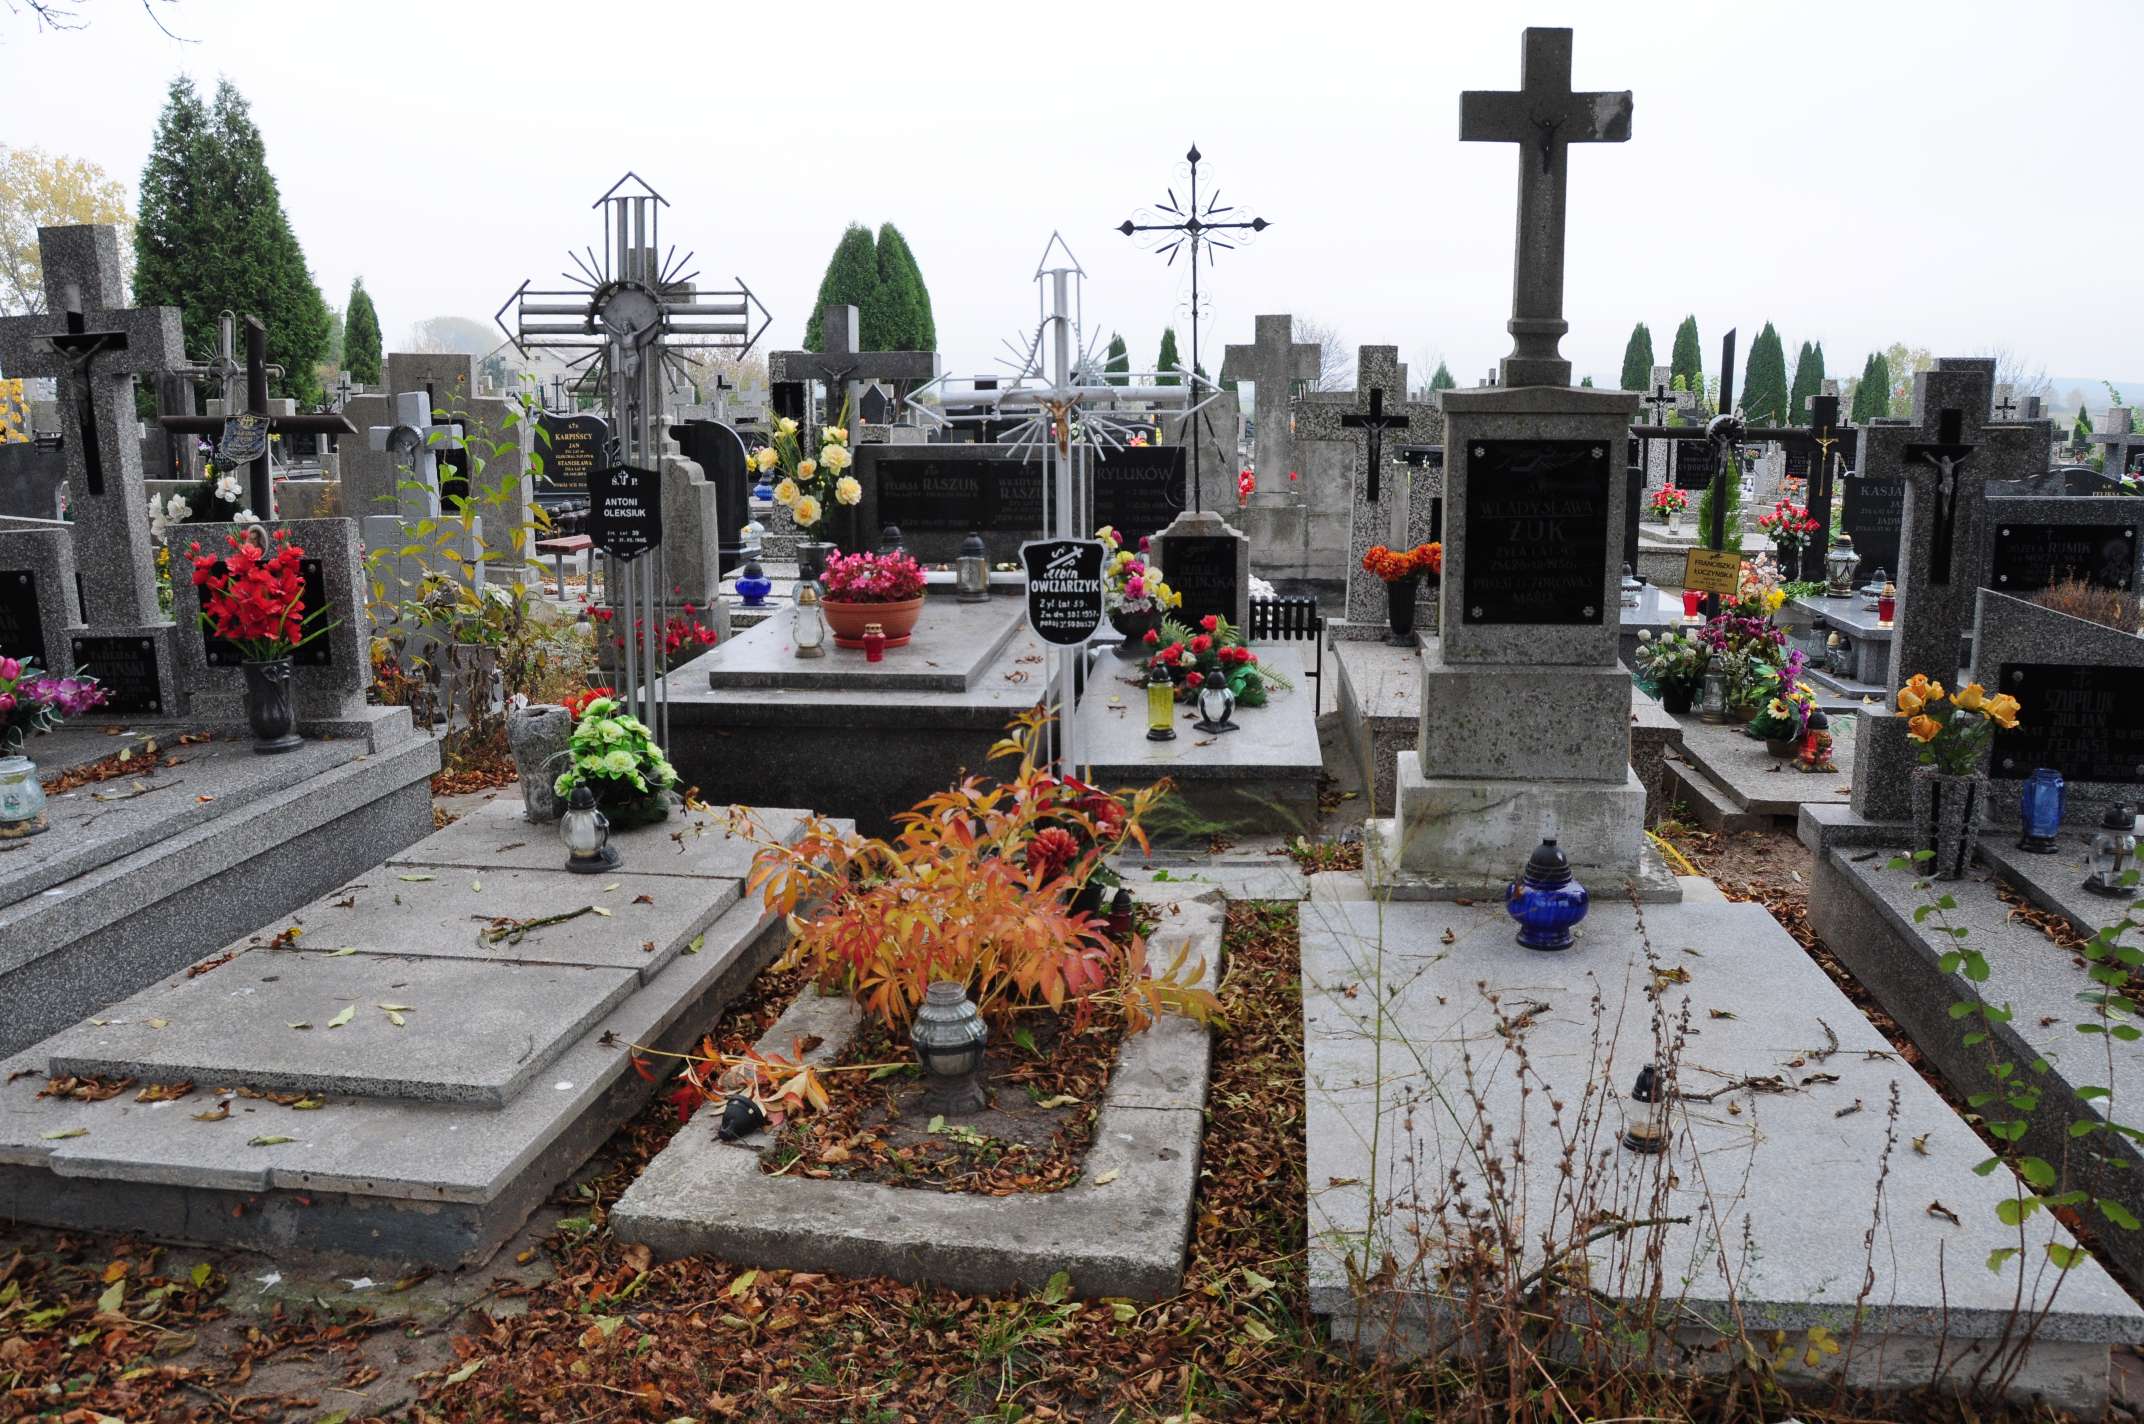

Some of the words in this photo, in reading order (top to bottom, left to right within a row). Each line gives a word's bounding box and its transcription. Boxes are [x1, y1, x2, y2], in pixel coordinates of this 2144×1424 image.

[555, 432, 593, 441] KARPIŃSCY
[922, 477, 980, 491] RASZUK
[605, 497, 638, 506] ANTONI
[603, 508, 646, 517] OLEKSIUK
[1480, 500, 1593, 515] WŁADYSŁAWA
[1031, 579, 1100, 593] OWCZARCZYK
